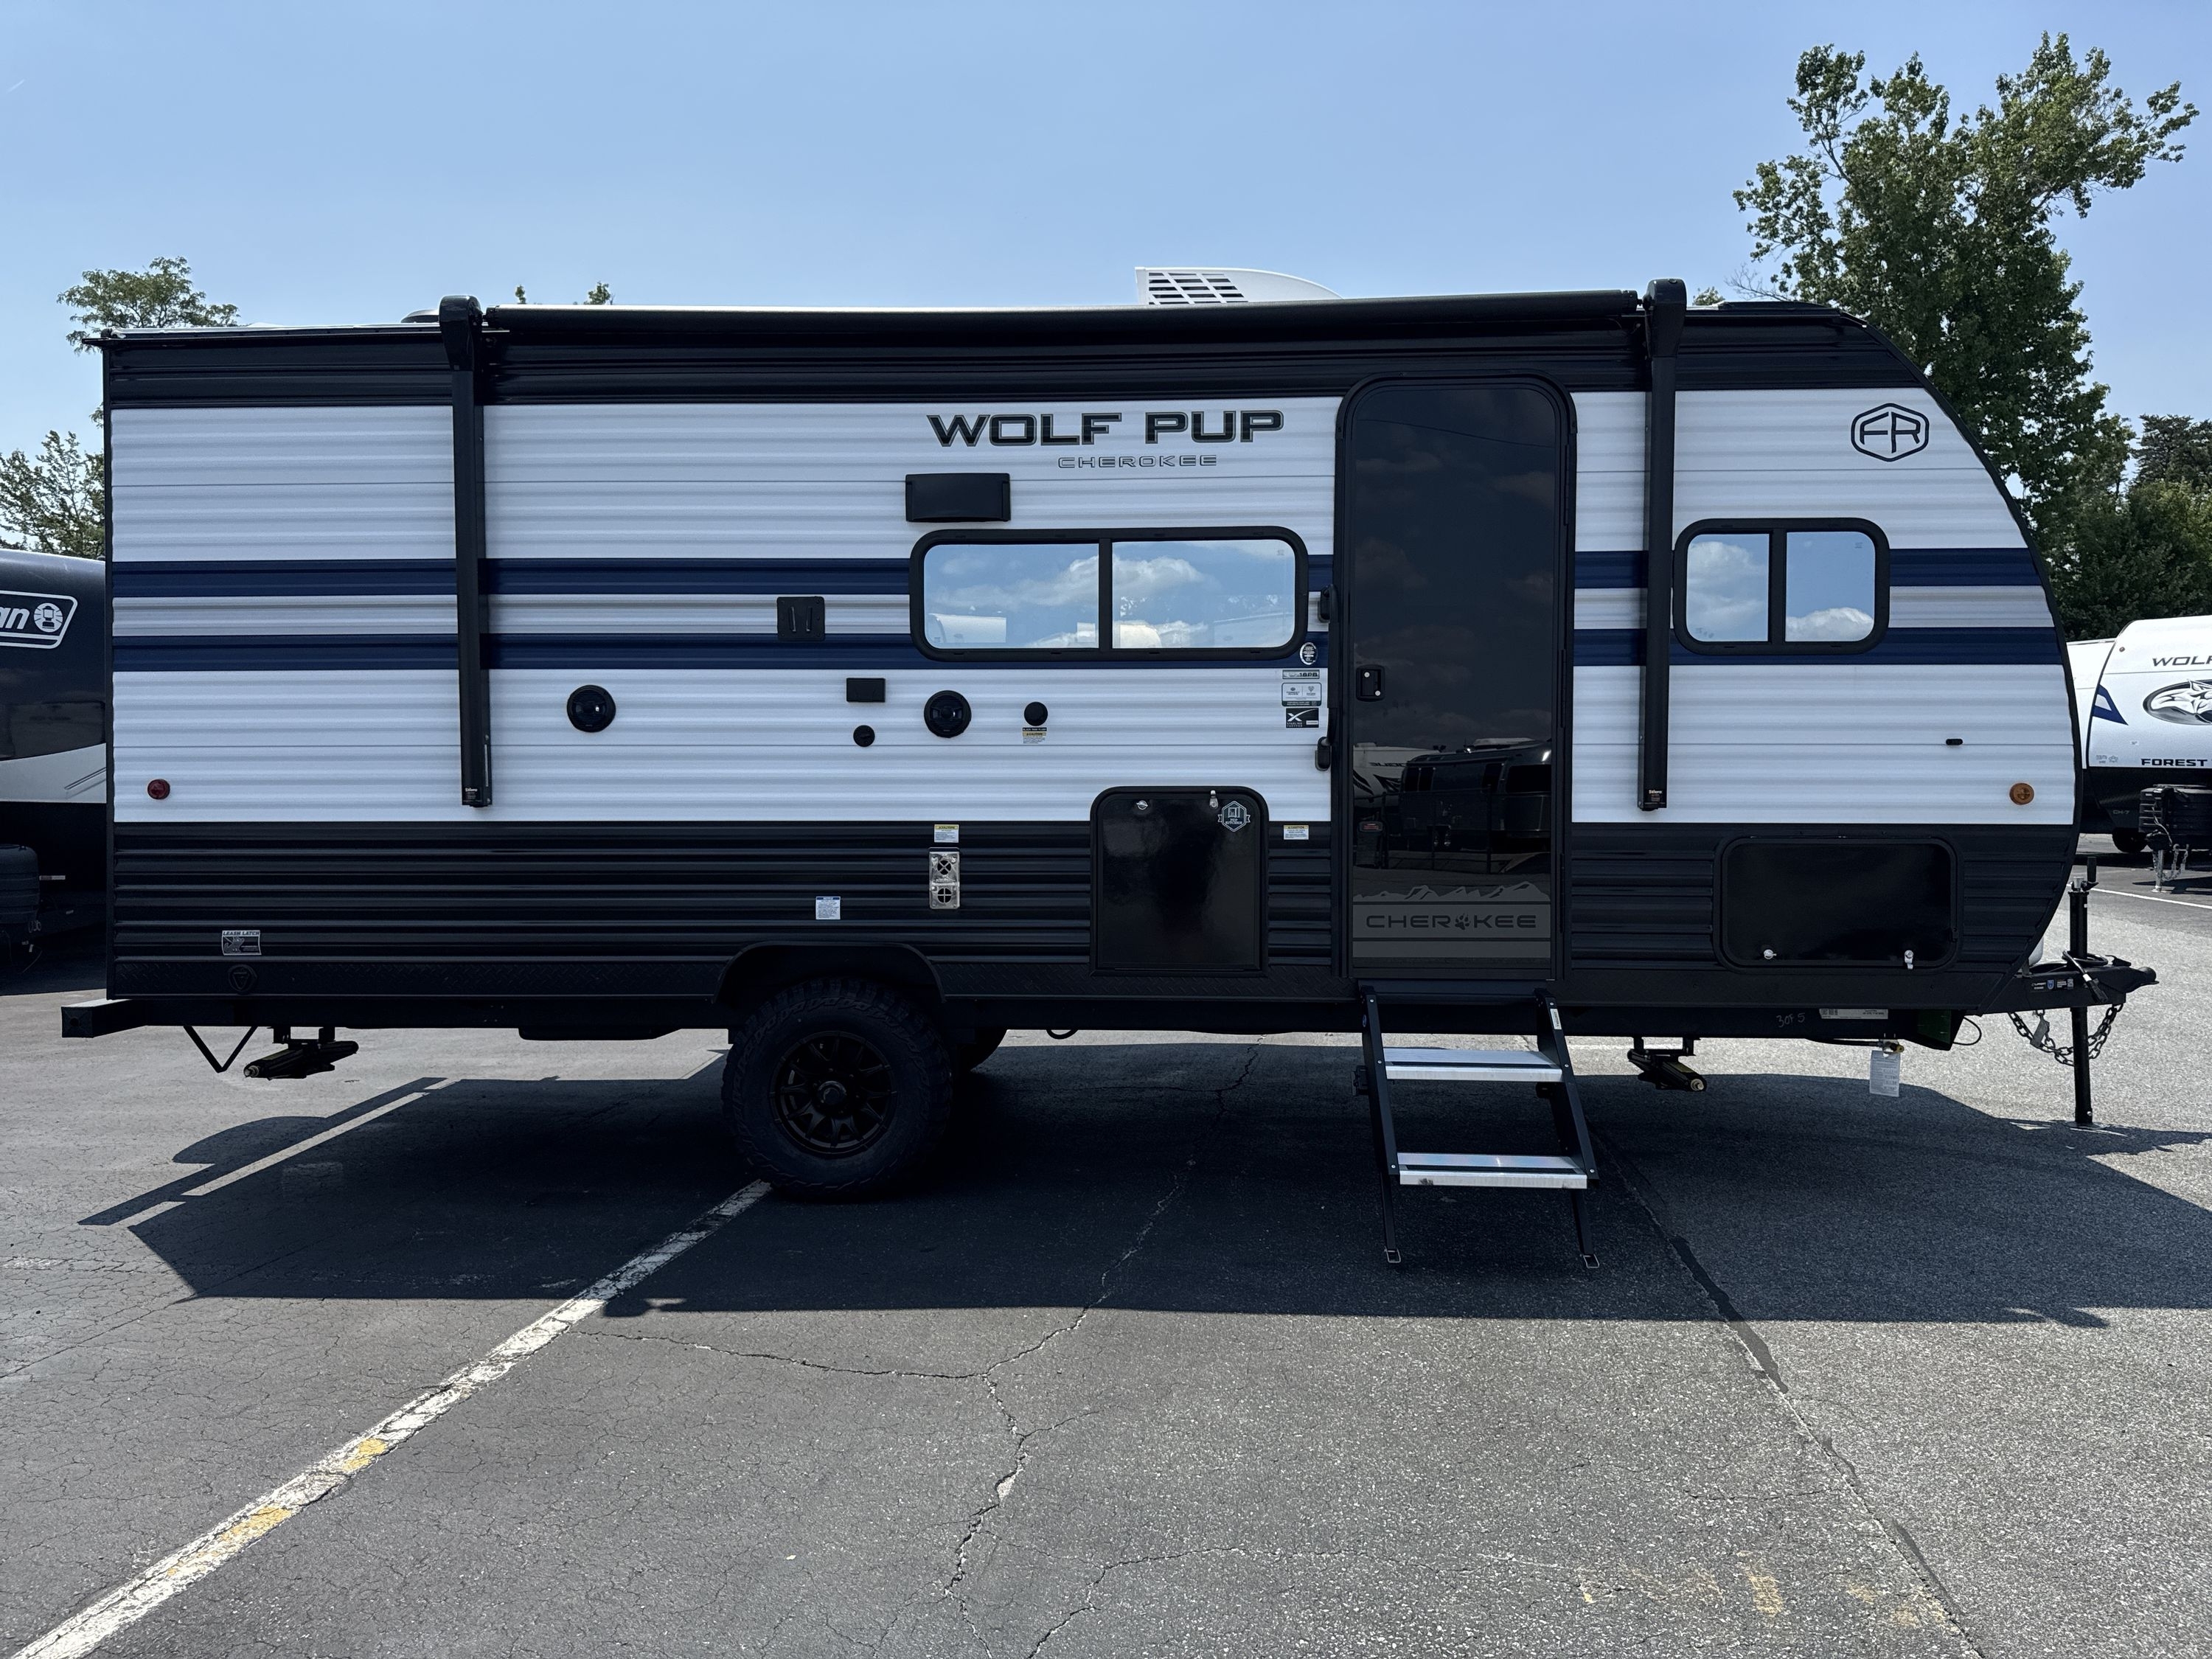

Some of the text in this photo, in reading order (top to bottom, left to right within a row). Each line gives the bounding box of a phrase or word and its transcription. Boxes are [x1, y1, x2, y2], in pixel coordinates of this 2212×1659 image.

[926, 409, 1284, 447] WOLF PUP
[1057, 453, 1217, 469] CHEROKEE
[2140, 758, 2208, 767] FOREST
[1797, 1012, 1806, 1023] 5
